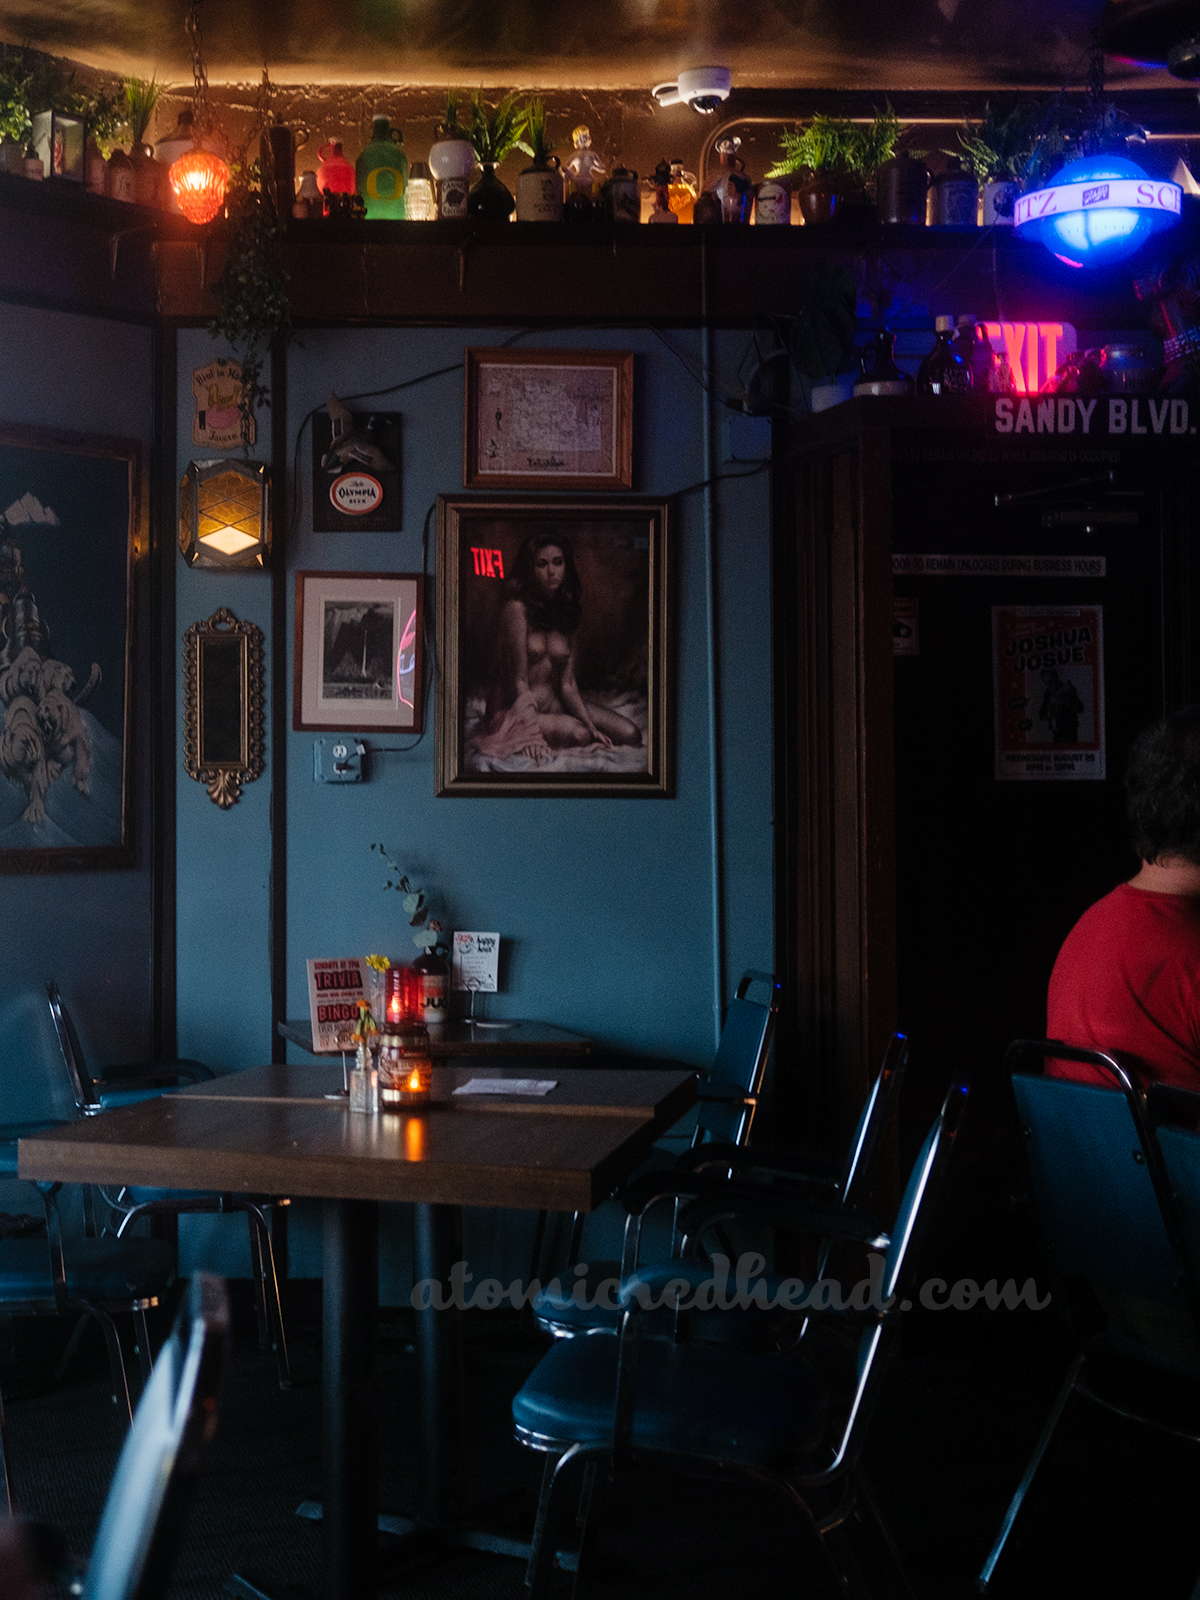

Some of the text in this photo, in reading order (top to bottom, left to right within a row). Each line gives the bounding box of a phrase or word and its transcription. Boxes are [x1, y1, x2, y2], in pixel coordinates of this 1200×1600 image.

[995, 398, 1197, 434] SANDY BLVD.
[1079, 450, 1121, 463] OCCUPIED
[338, 487, 377, 499] OLYMPIA
[893, 558, 1102, 572] OOR TO REMAIN UNLOCKED DURING BUSINESS HOURS
[1004, 627, 1092, 656] JOSHUA
[1013, 646, 1084, 673] JOSUE
[1053, 753, 1083, 762] AUGUST
[316, 971, 360, 989] TRIVIA
[318, 1005, 358, 1022] BINGO
